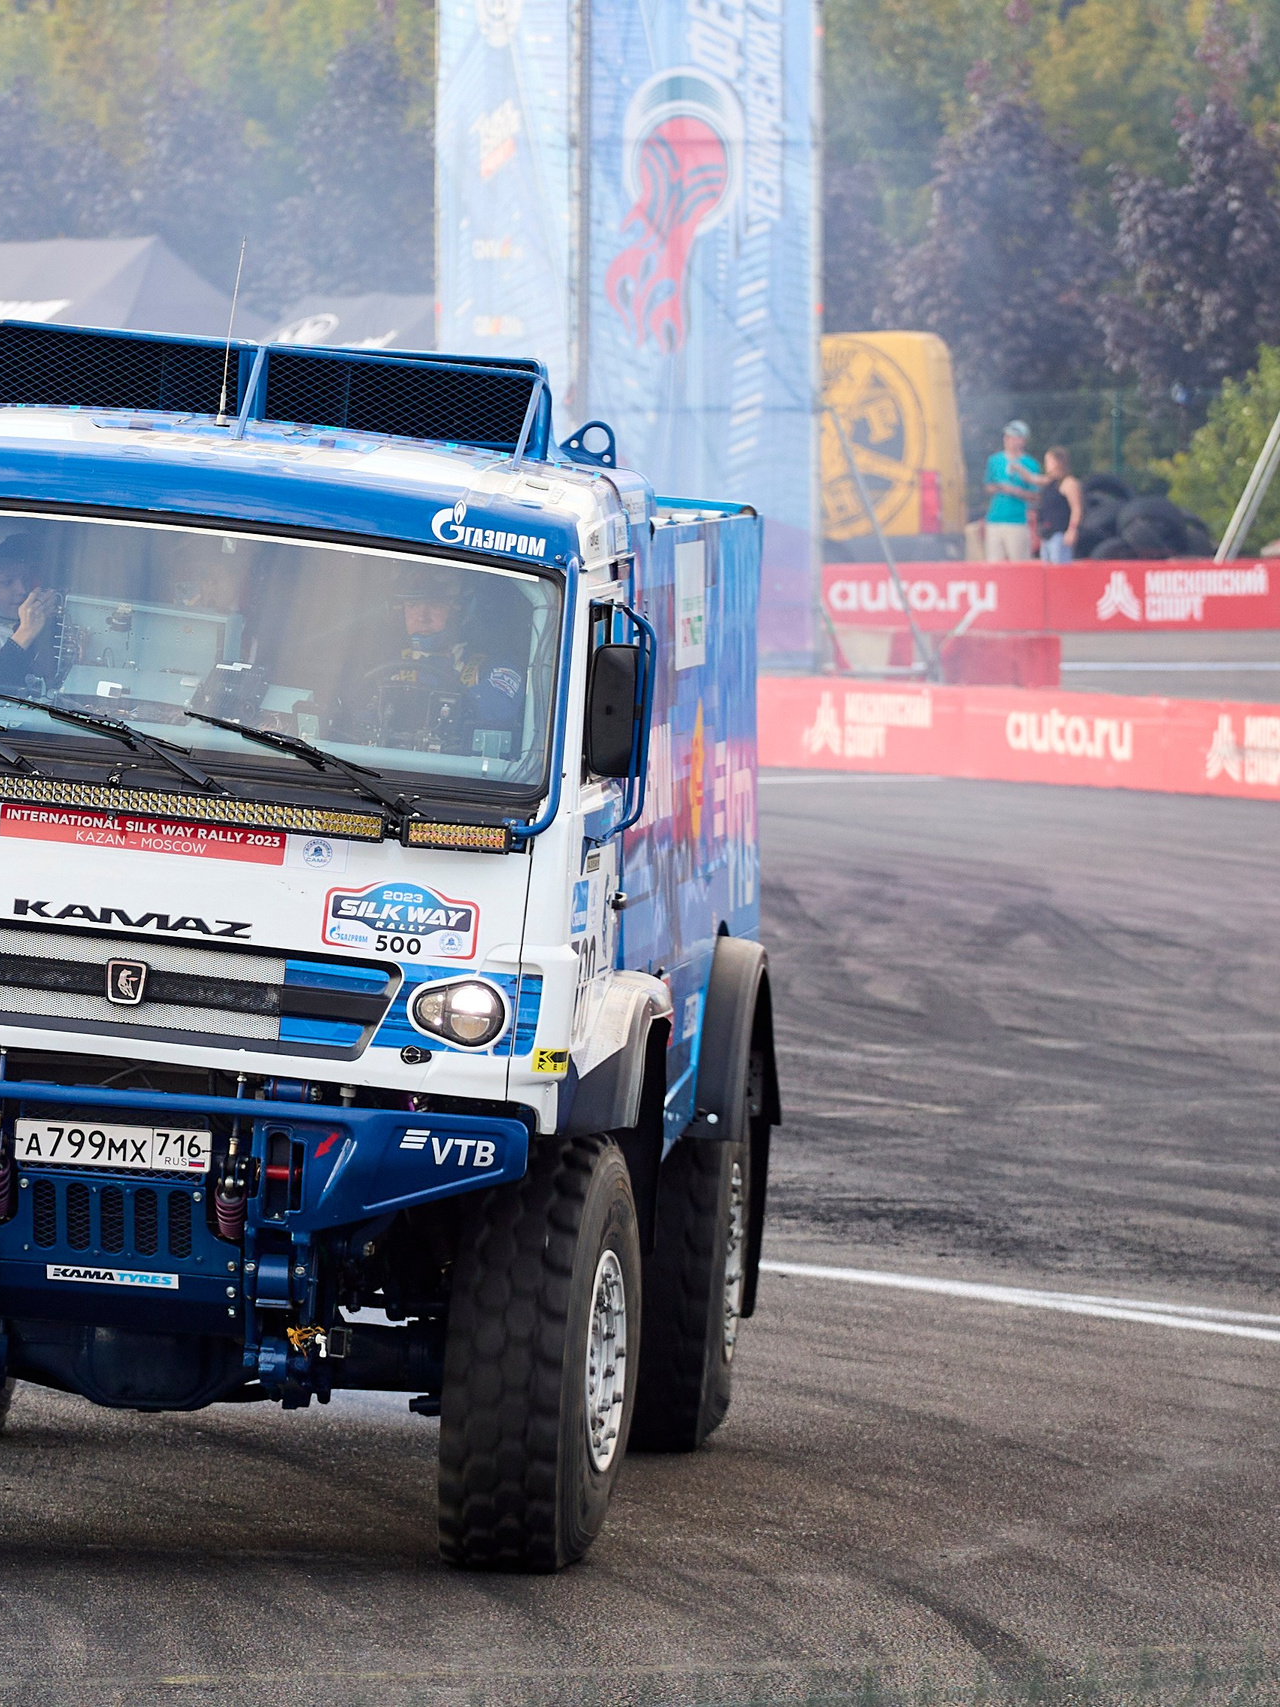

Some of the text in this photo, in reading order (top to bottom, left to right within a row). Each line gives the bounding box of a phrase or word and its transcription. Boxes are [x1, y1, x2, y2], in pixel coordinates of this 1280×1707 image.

[828, 580, 998, 612] auto.ru
[1006, 708, 1133, 761] auto.ru
[6, 808, 281, 848] INTERNATIONAL SILK WAY RALLY 2023
[75, 830, 126, 846] KAZAN
[140, 837, 207, 855] MOSCOW
[382, 890, 424, 903] 2023
[13, 898, 253, 939] KAMAZ
[337, 899, 467, 927] SILK WAY
[339, 933, 368, 943] GAZPROM
[375, 921, 426, 933] RALLY
[375, 934, 422, 955] 500
[156, 1133, 201, 1157] 716
[431, 1137, 496, 1167] VTB
[165, 1156, 188, 1167] RUS
